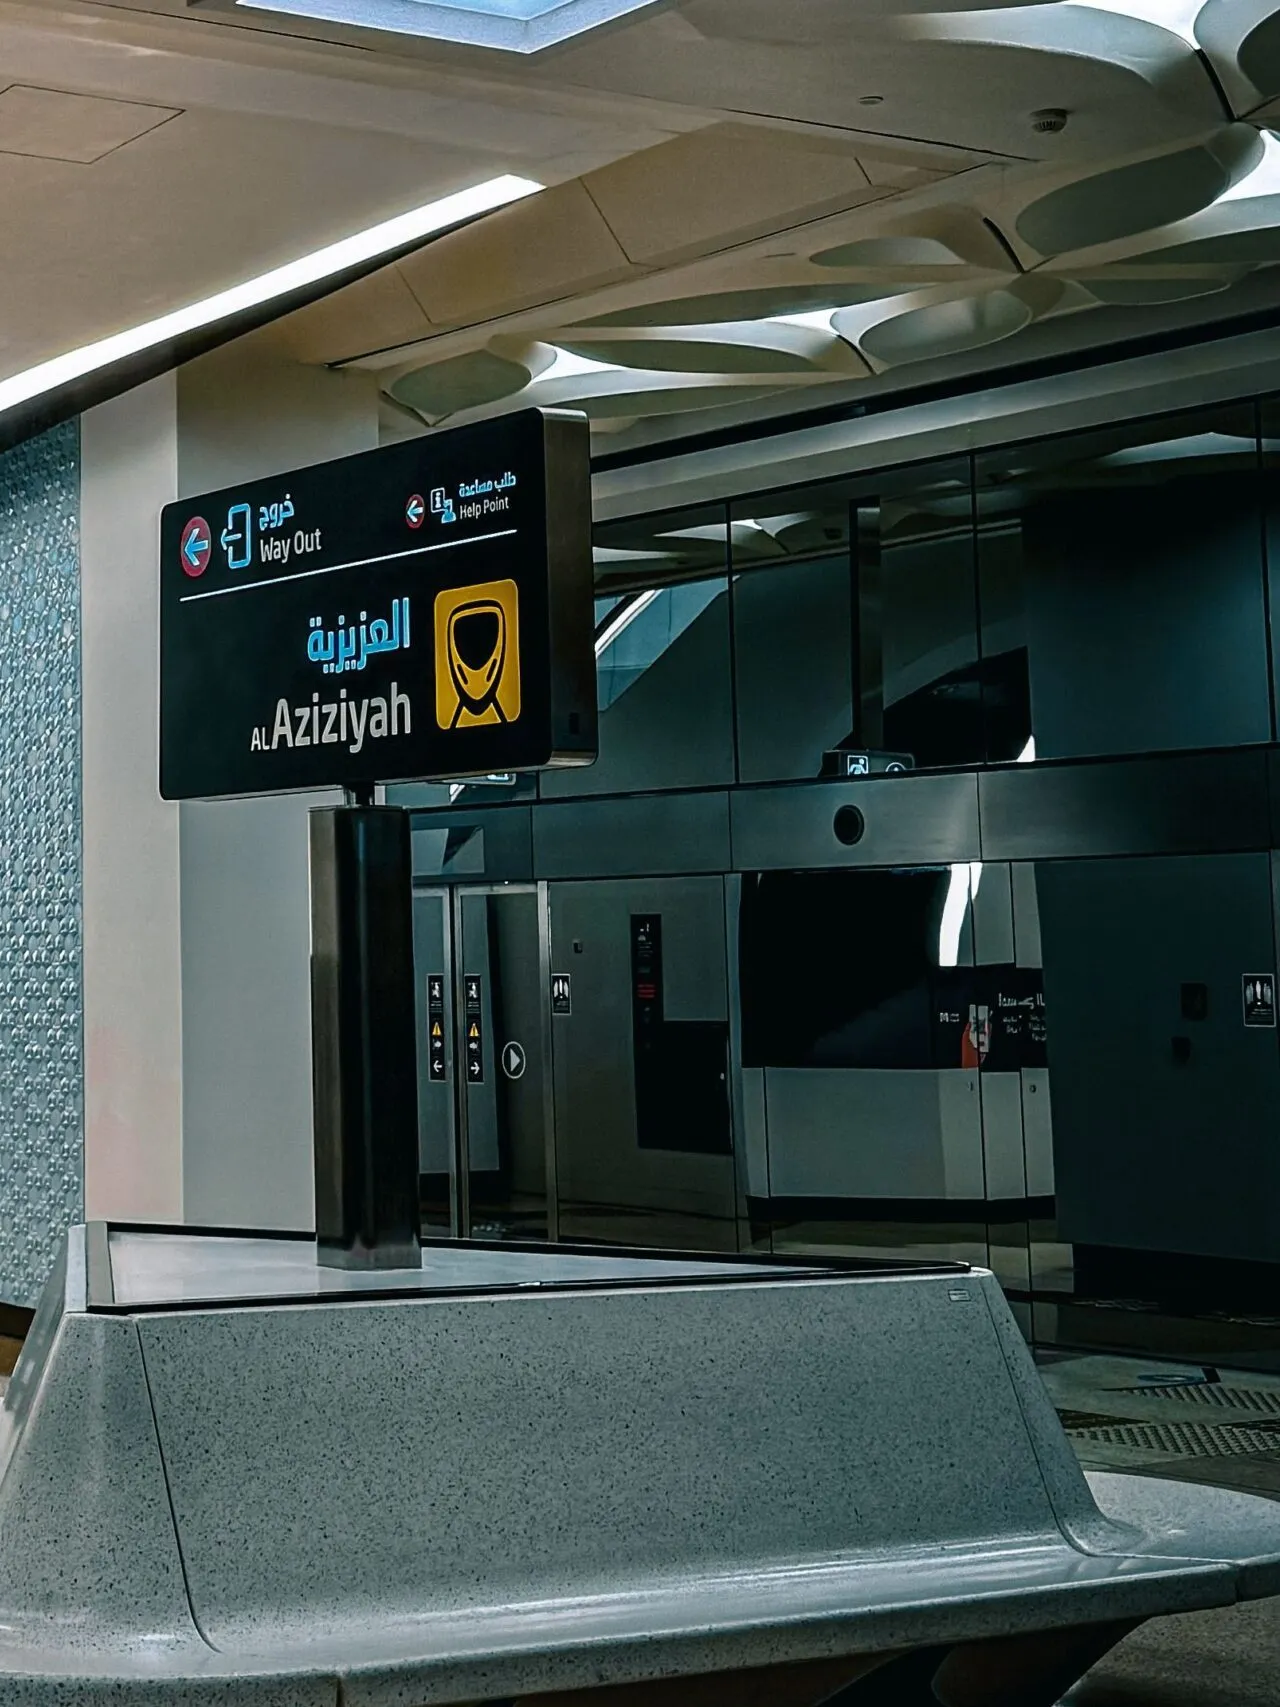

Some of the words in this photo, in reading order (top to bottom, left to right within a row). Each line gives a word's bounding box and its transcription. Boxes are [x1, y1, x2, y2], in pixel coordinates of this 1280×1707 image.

[459, 479, 493, 498] مساعدة
[494, 471, 517, 493] طلب
[259, 493, 295, 531] خروج
[459, 501, 482, 520] Help
[483, 496, 510, 514] Point
[260, 536, 291, 564] Way
[293, 527, 322, 555] Out
[307, 597, 410, 673] العزيزية
